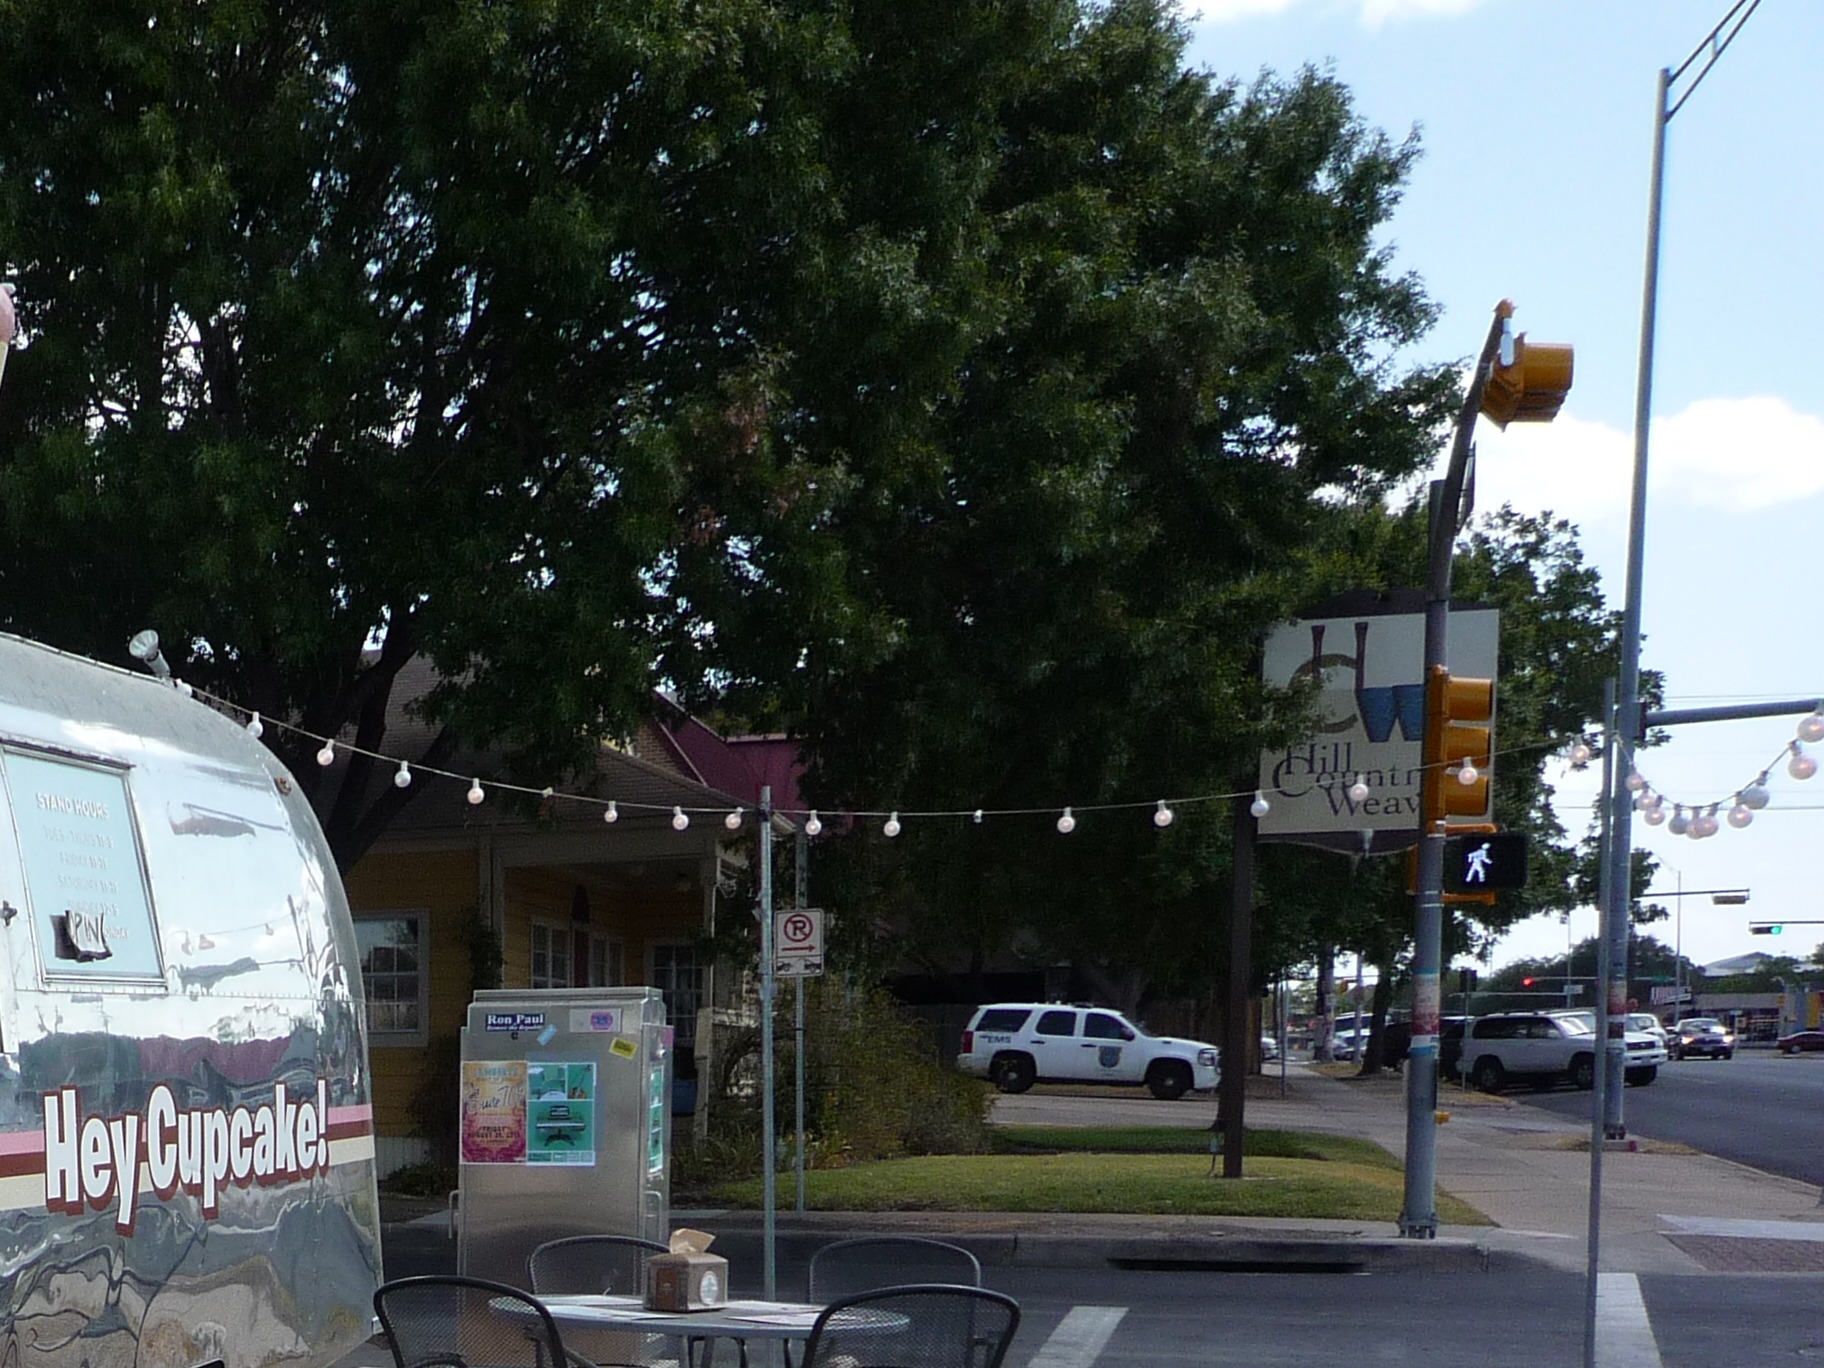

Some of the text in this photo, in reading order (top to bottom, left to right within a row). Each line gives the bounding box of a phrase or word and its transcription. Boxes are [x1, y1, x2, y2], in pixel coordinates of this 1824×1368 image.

[1284, 742, 1352, 775] Hill
[1272, 756, 1422, 798] Countr
[36, 792, 110, 819] STAND HOURS
[1324, 786, 1421, 818] Weav
[487, 1014, 544, 1025] Ron Paul
[987, 1035, 1011, 1044] EMS
[44, 1078, 330, 1233] Hey Cupcake!
